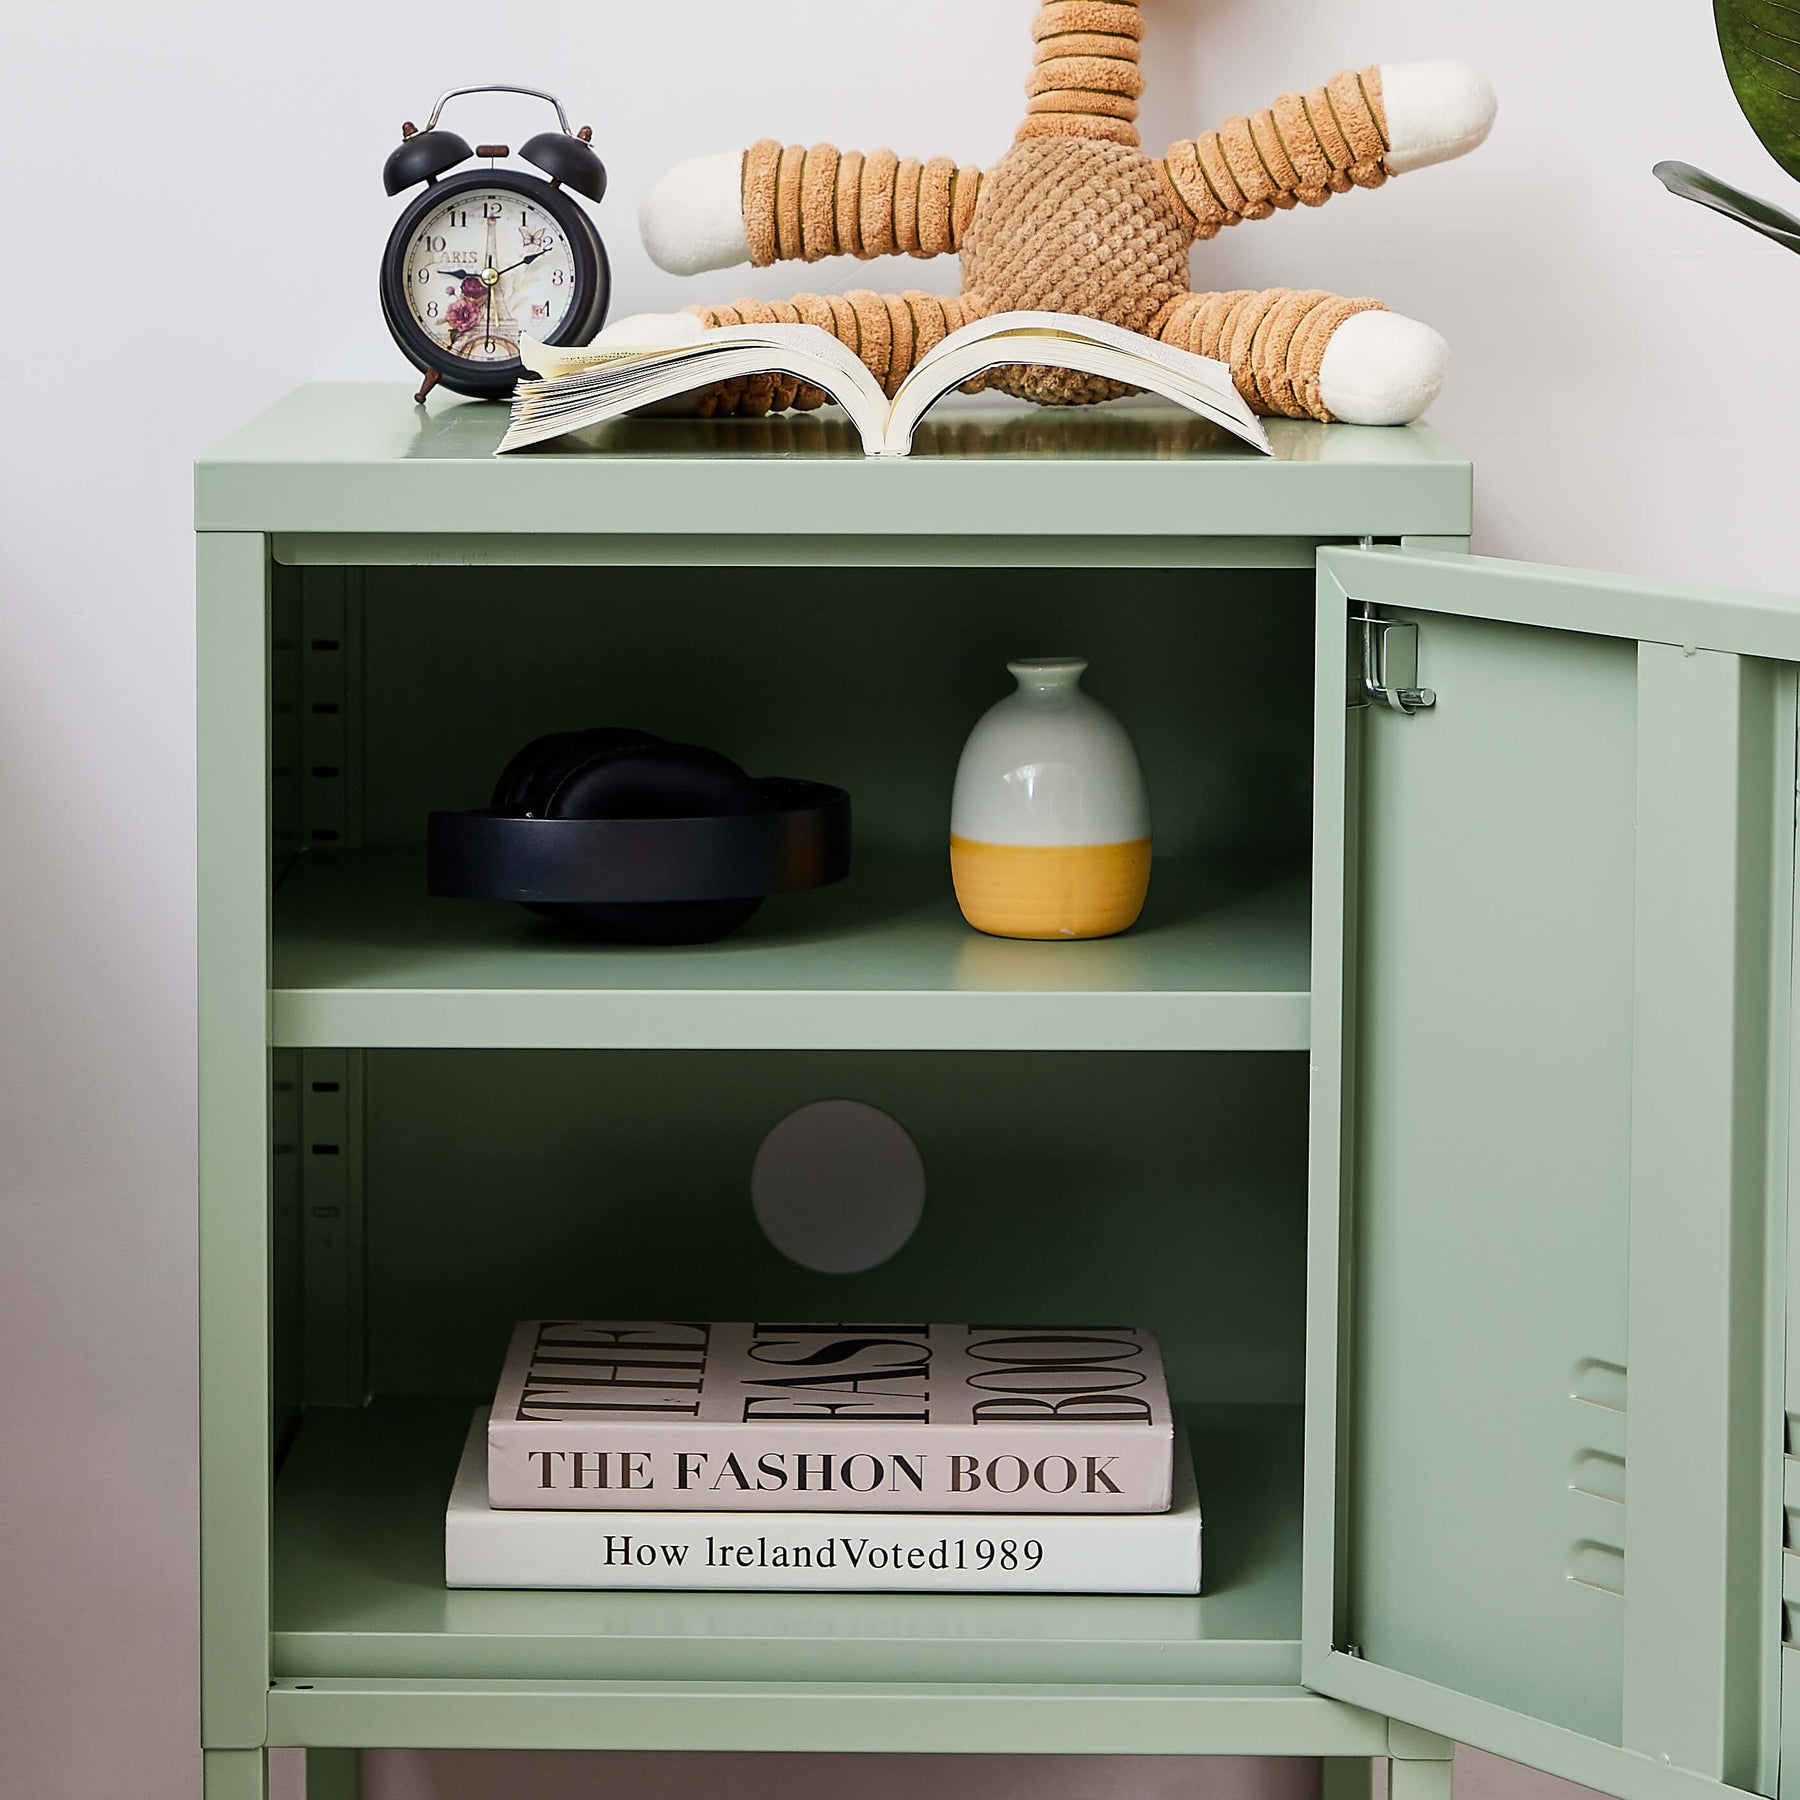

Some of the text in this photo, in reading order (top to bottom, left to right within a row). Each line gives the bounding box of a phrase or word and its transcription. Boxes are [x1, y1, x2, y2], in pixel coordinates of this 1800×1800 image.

[483, 203, 502, 218] 12
[450, 211, 467, 227] 11
[521, 211, 527, 227] 1
[426, 235, 446, 252] 10
[542, 236, 553, 250] 2
[418, 268, 430, 284] 9
[552, 269, 563, 286] 3
[427, 301, 438, 317] 8
[515, 1322, 711, 1421] THE
[528, 1451, 1125, 1494] THE FASHON BOOK
[603, 1535, 689, 1567] How
